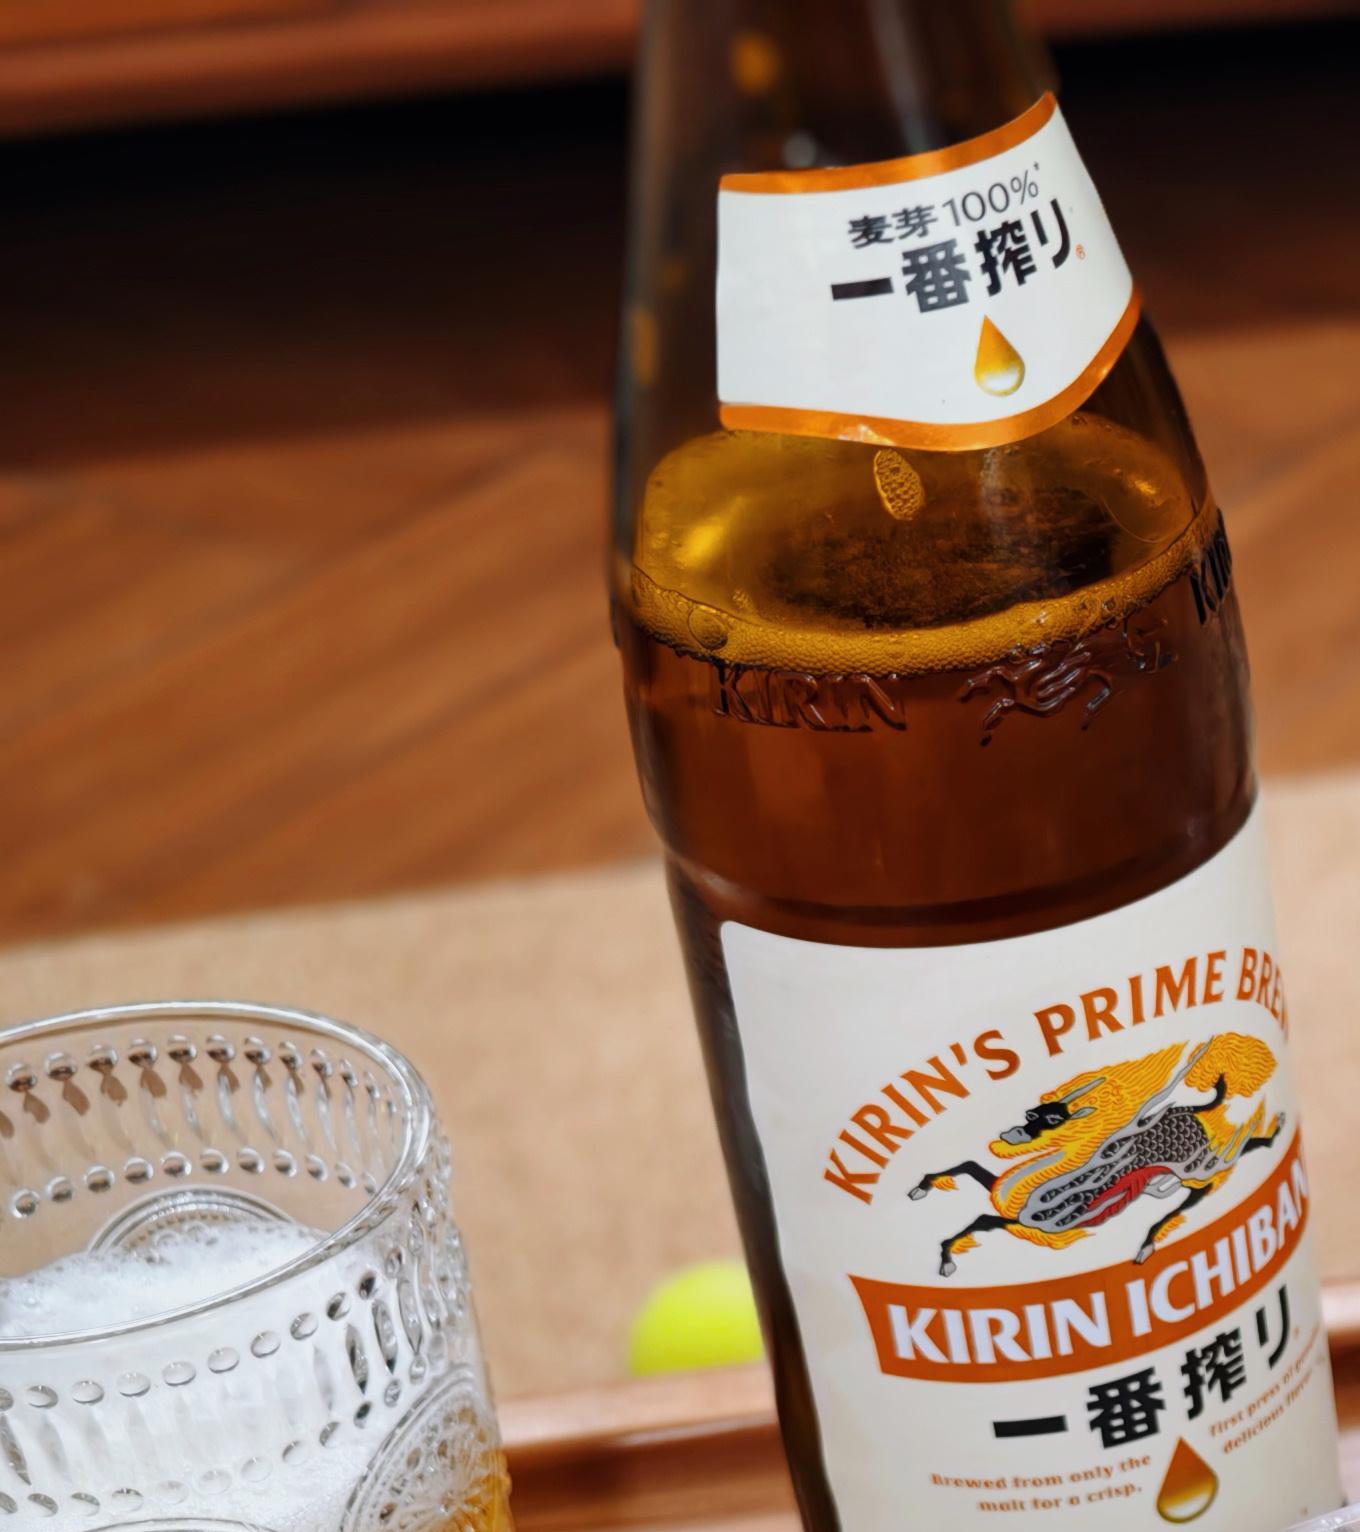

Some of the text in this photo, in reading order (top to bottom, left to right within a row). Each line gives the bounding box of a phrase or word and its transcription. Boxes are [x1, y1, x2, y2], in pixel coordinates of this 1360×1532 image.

[831, 198, 1072, 313] 一番搾り
[714, 655, 907, 732] KIRIN
[824, 1029, 1021, 1206] KIRIN'S
[1034, 950, 1227, 1057] PRIME
[888, 1158, 1310, 1364] KIRIN ICHIBAN
[992, 1284, 1289, 1449] 一番搾り
[930, 1472, 1007, 1490] Brewed
[1013, 1473, 1063, 1489] from
[1069, 1464, 1113, 1483] only
[1118, 1454, 1152, 1472] the
[977, 1497, 1026, 1513] malt
[1031, 1495, 1063, 1511] for
[1068, 1494, 1081, 1507] a
